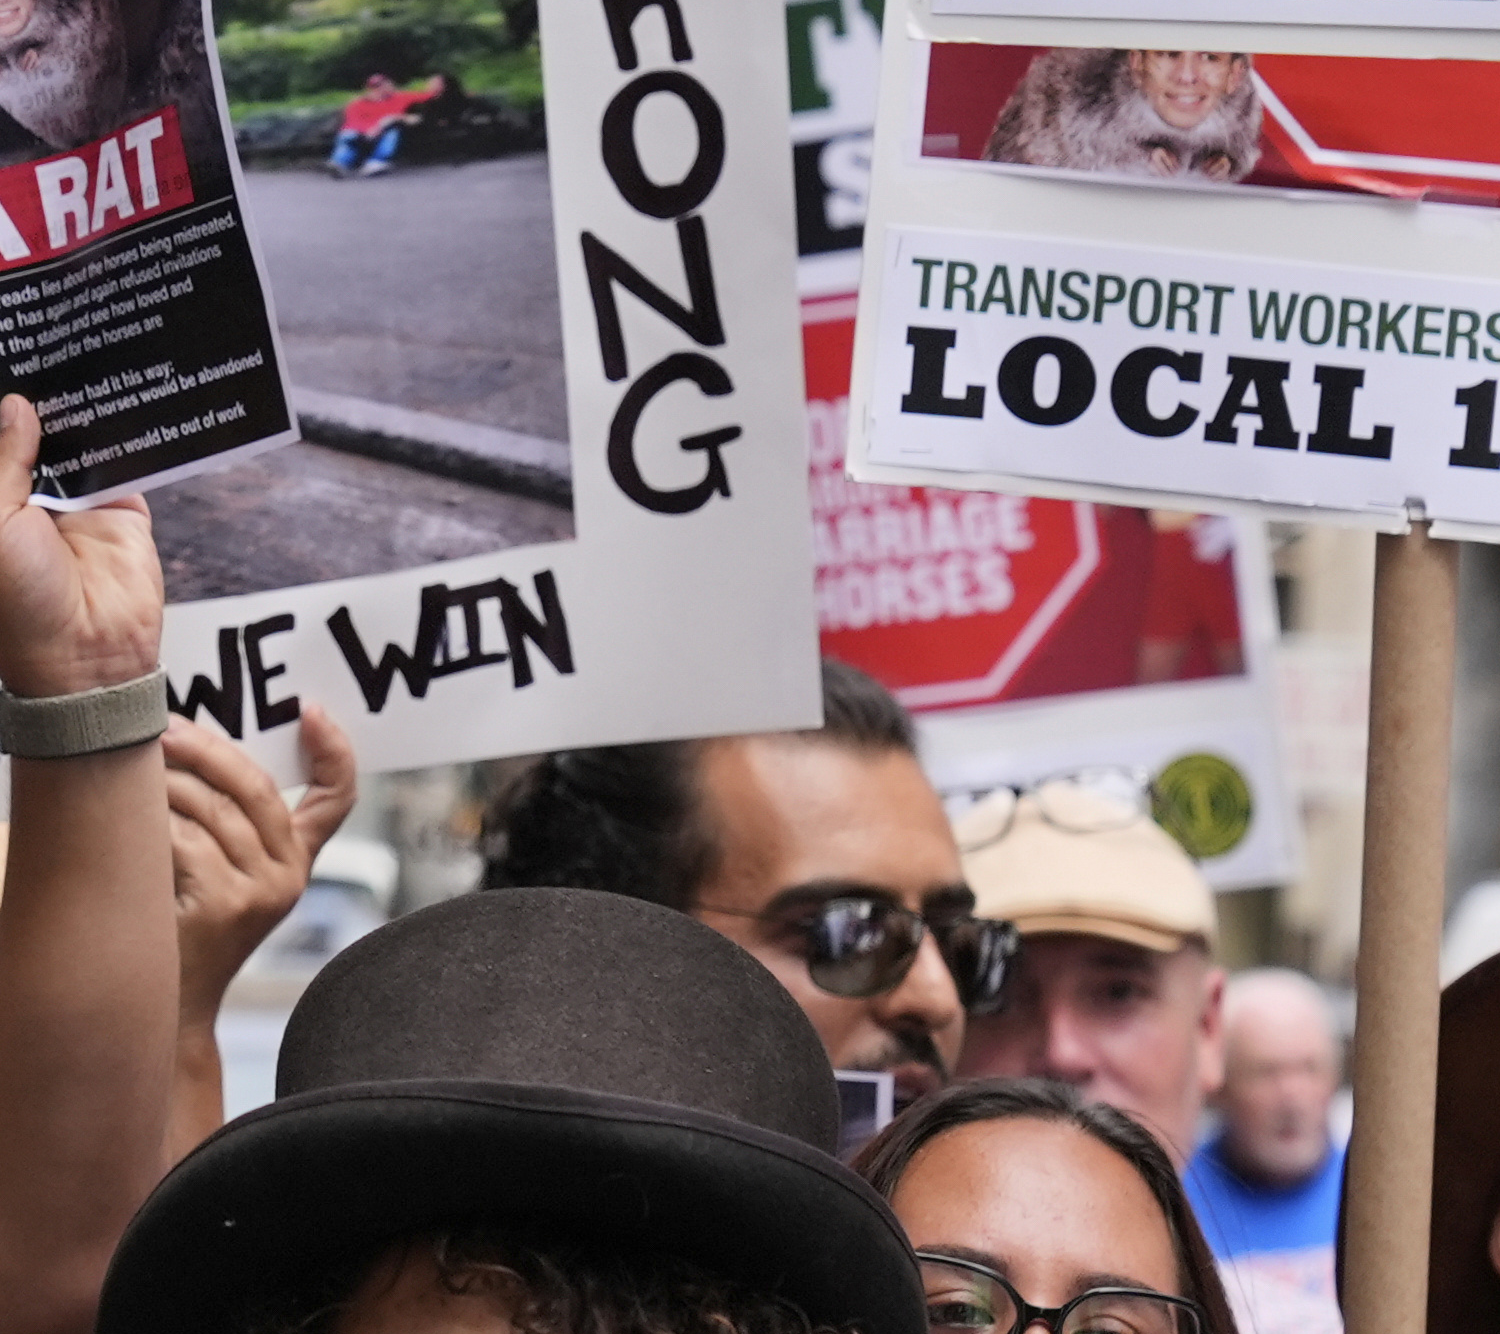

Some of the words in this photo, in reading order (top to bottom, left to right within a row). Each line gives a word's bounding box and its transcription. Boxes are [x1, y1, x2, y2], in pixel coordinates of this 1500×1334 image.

[34, 115, 164, 251] RAT
[910, 257, 1237, 337] TRANSPORT
[140, 378, 179, 403] would
[179, 372, 196, 390] be
[198, 348, 264, 385] abandoned
[900, 325, 1394, 461] LOCAL
[326, 568, 576, 714] WIN
